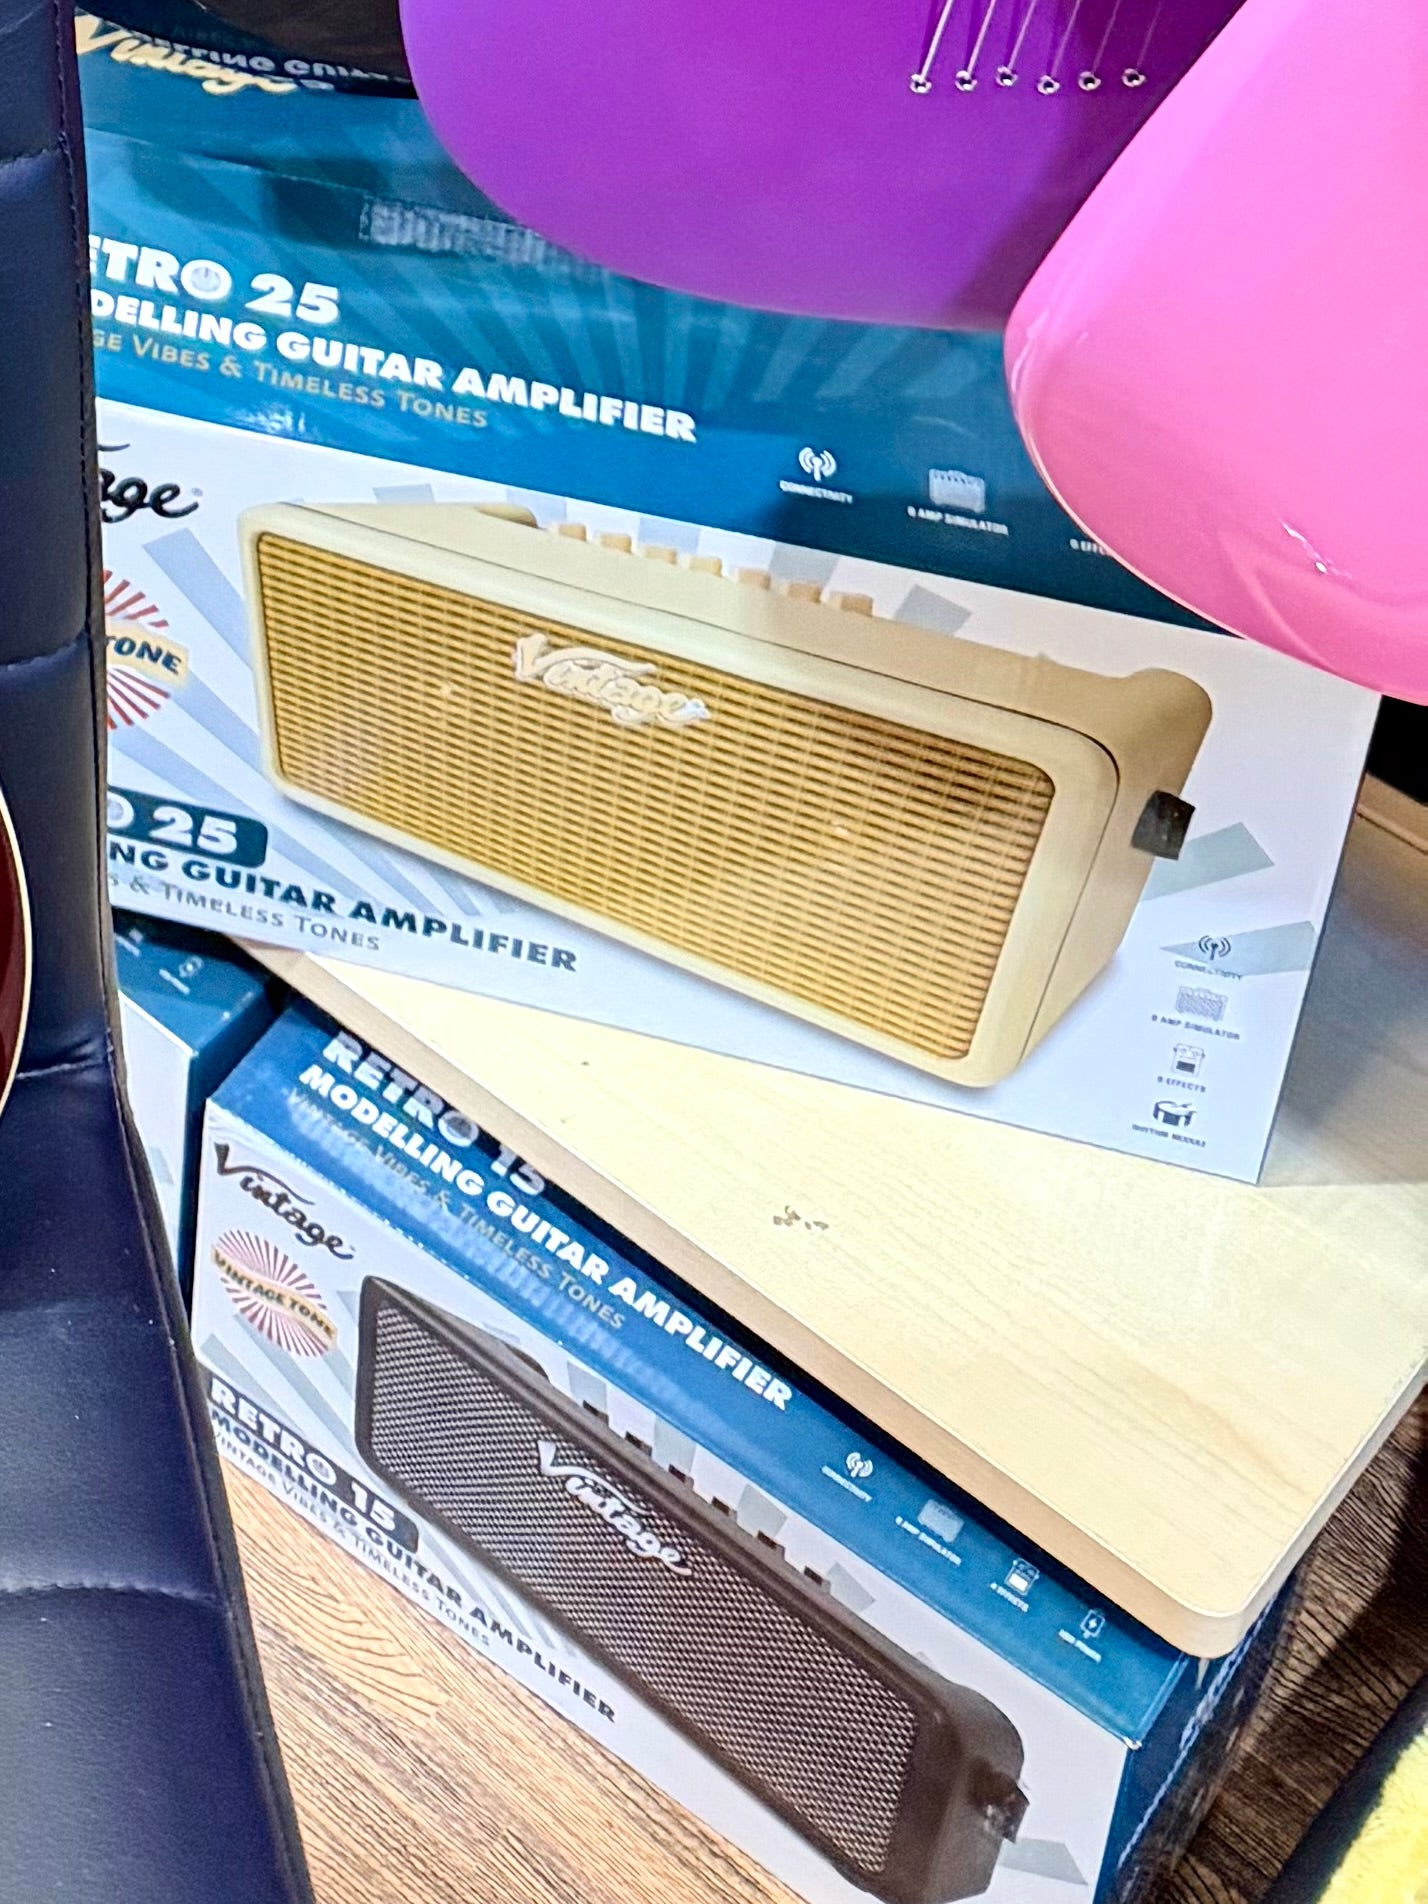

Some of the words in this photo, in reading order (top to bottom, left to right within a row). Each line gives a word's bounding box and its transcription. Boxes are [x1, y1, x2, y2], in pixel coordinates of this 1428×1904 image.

[248, 273, 340, 324] 25
[131, 334, 211, 372] VIBES
[220, 356, 243, 379] &
[253, 361, 386, 409] TIMELESS
[398, 391, 489, 429] TONES
[276, 330, 445, 391] GUITAR
[451, 368, 698, 443] AMPLIFIER
[150, 807, 238, 855] 25
[164, 884, 285, 928] TIMELESS
[295, 914, 381, 951] TONES
[181, 858, 338, 915] GUITAR
[350, 900, 579, 972] AMPLIFIER
[322, 1030, 479, 1148] RETRO
[214, 1142, 355, 1260] Vintage
[299, 1064, 484, 1197] MODELLING
[486, 1193, 610, 1286] GUITAR
[608, 1278, 794, 1412] AMPLIFIER
[560, 1274, 628, 1330] TONES
[211, 1377, 339, 1487] RETRO
[350, 1483, 397, 1532] 15
[537, 1440, 694, 1577] Vintage
[211, 1411, 359, 1532] MODELLING
[366, 1525, 463, 1607] GUITAR
[470, 1606, 616, 1723] AMPLIFIER
